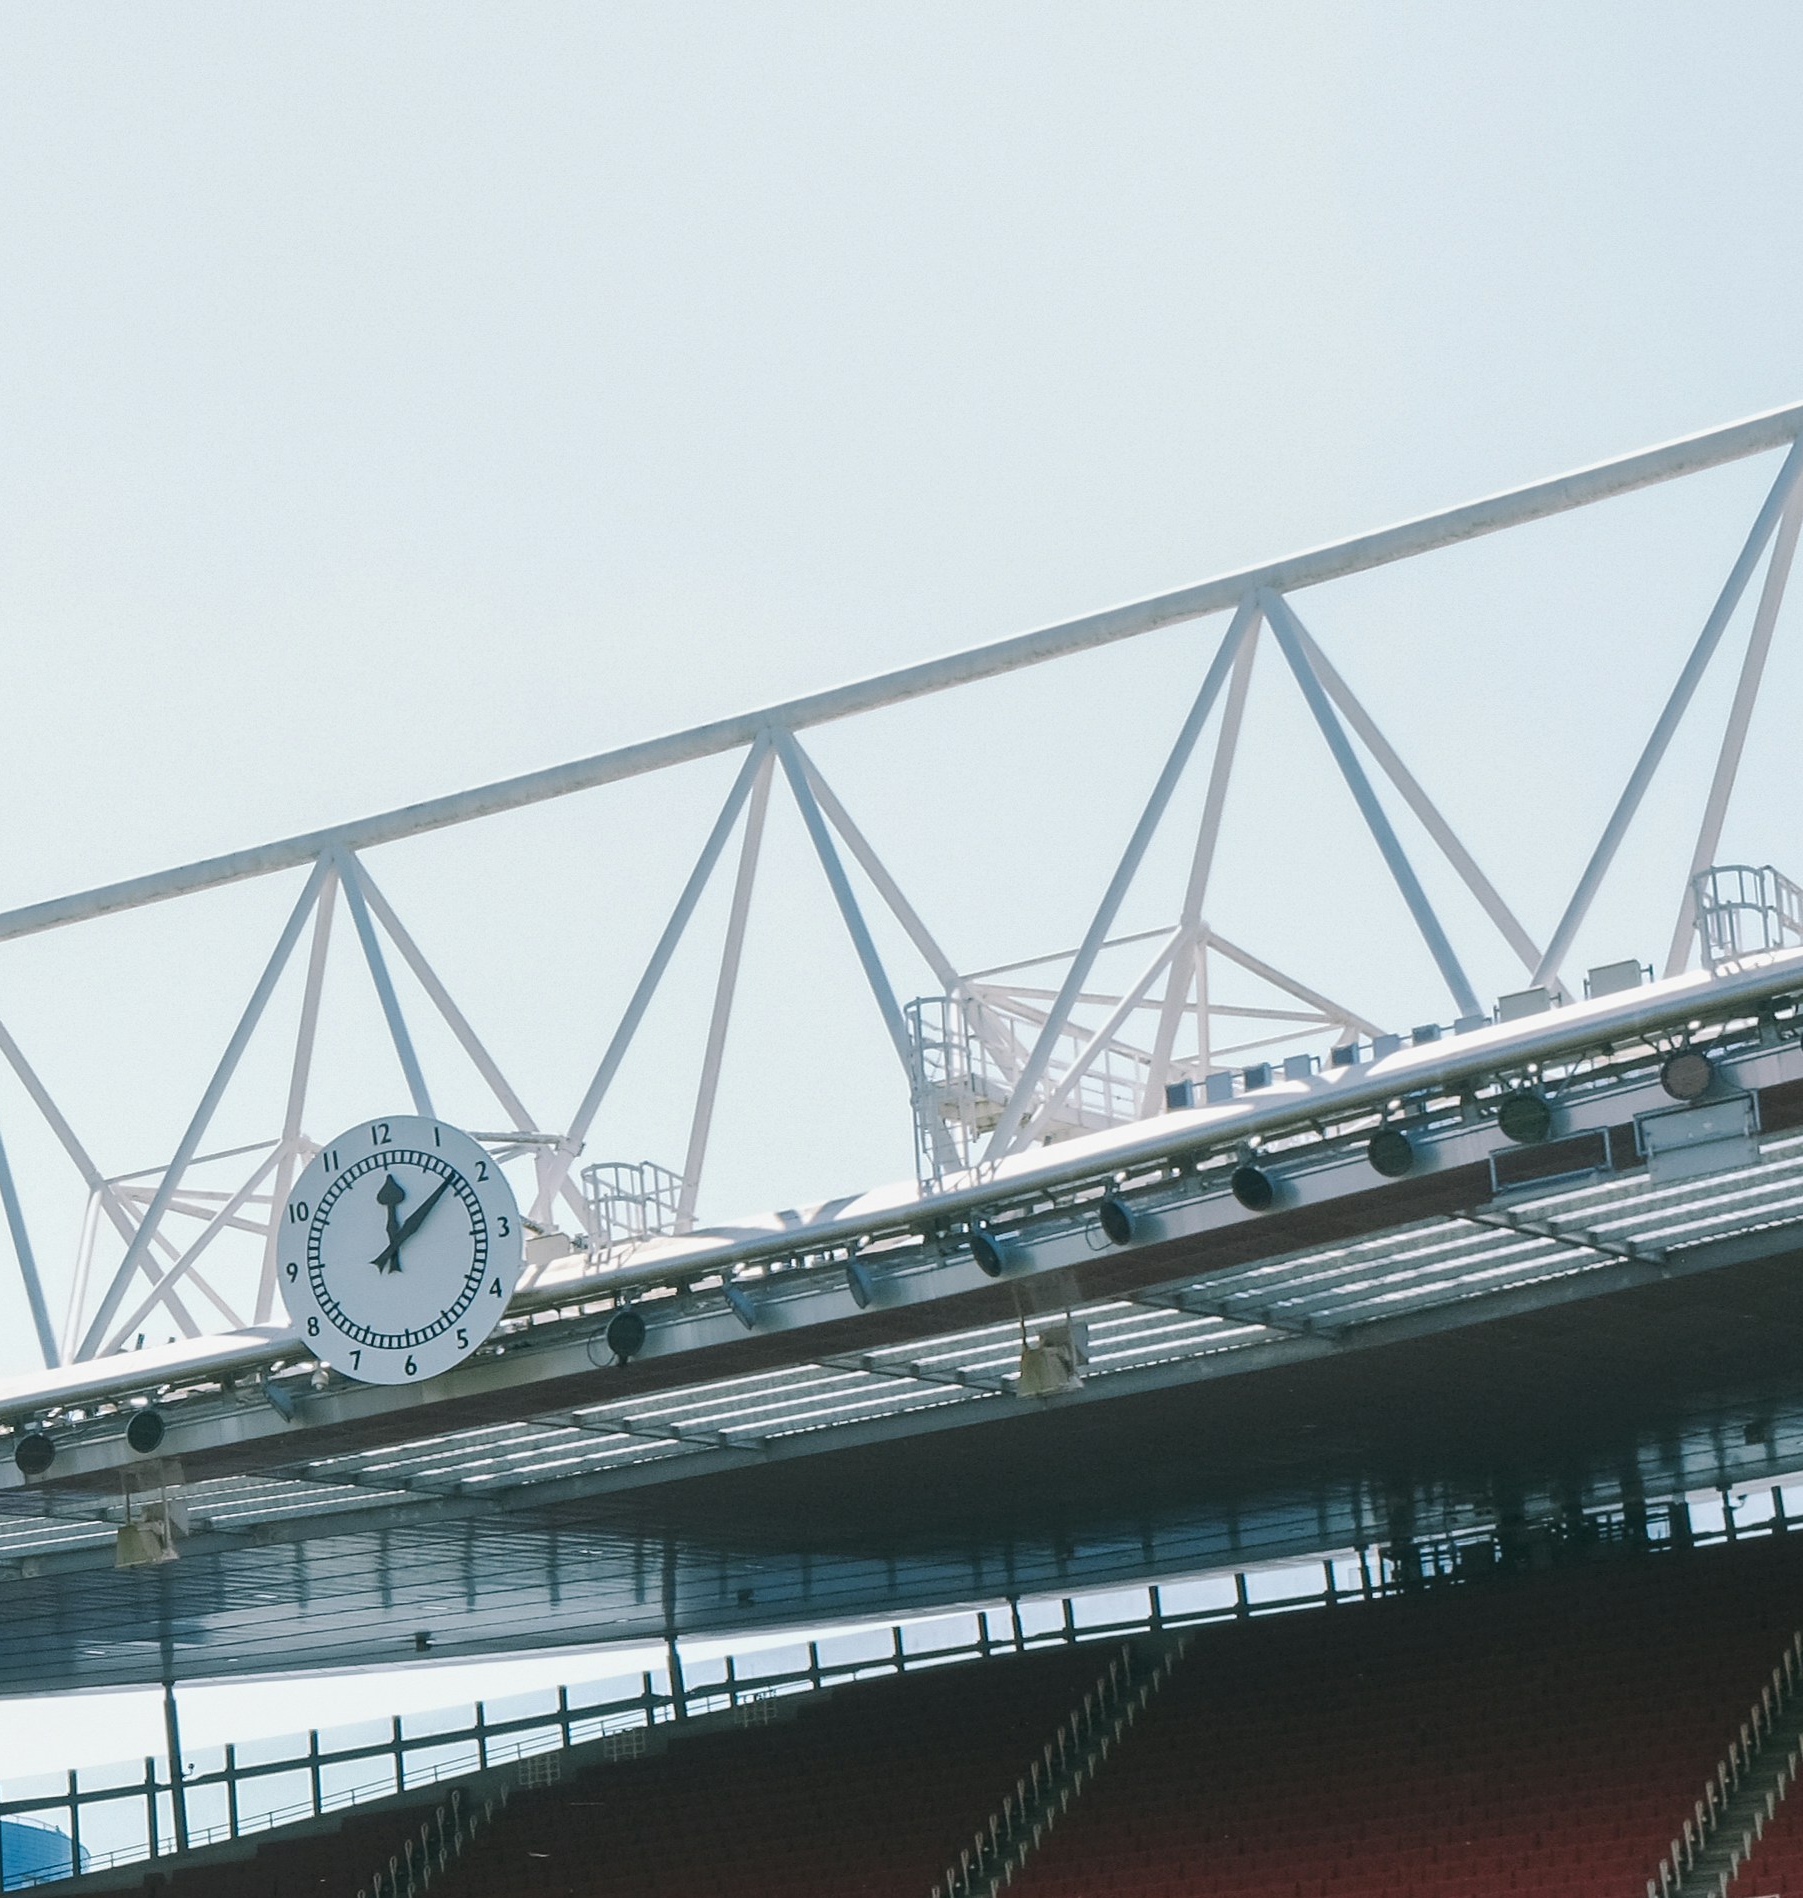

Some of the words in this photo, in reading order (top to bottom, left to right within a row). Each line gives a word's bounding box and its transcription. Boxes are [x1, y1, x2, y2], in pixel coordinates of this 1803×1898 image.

[371, 1123, 393, 1145] 12
[434, 1126, 441, 1147] 1
[322, 1151, 339, 1172] 11
[475, 1161, 489, 1182] 2
[288, 1201, 309, 1224] 10
[497, 1216, 510, 1238] 3
[286, 1262, 299, 1284] 9
[489, 1277, 503, 1298] 4
[307, 1316, 320, 1337] 8
[457, 1328, 469, 1350] 5
[349, 1350, 362, 1371] 7
[405, 1355, 418, 1376] 6
